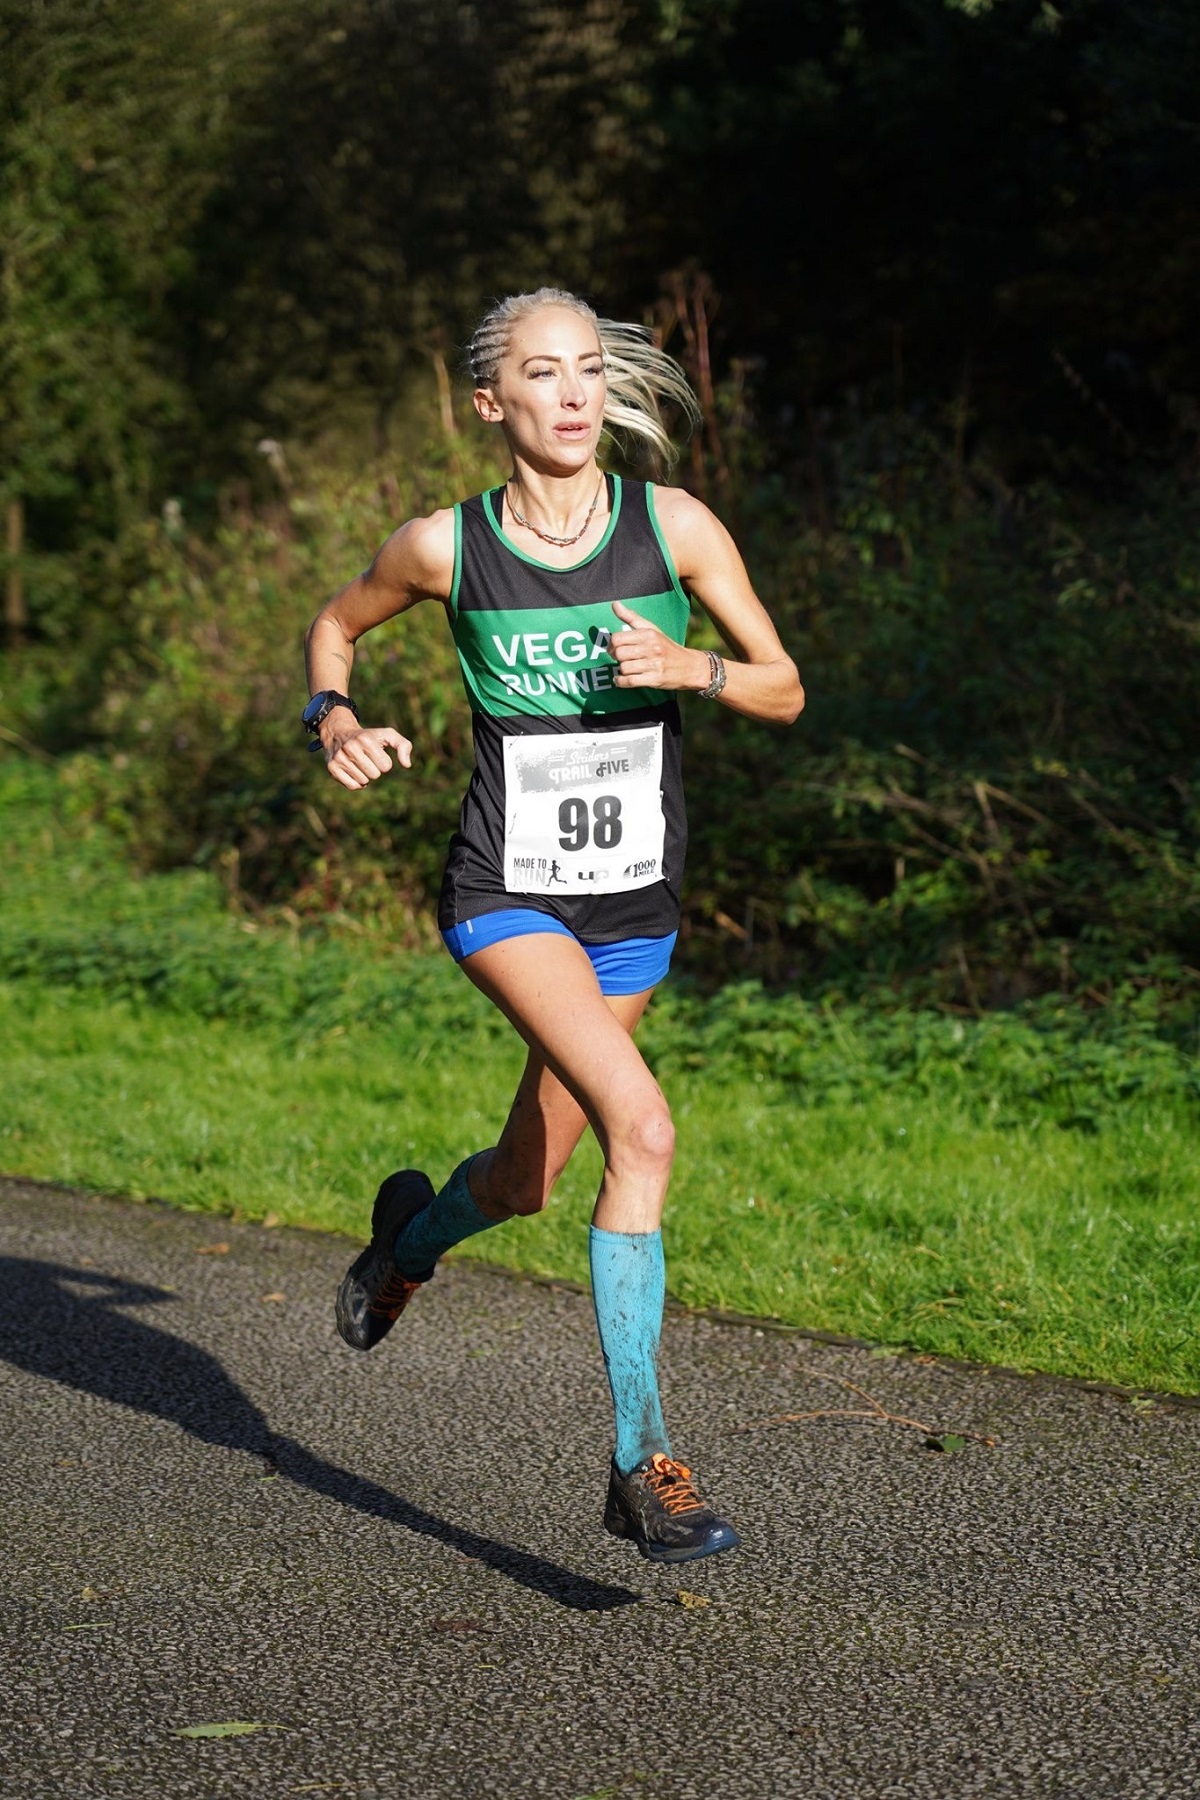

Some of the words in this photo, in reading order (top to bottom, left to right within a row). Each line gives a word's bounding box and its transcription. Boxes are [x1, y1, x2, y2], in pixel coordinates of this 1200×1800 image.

[492, 624, 632, 667] VEGA
[499, 666, 621, 696] RUNNE
[548, 764, 592, 784] TRAIL
[595, 758, 630, 778] FIVE
[558, 795, 623, 852] 98
[513, 857, 535, 869] MADE
[537, 857, 547, 869] TO
[632, 858, 656, 878] 1000
[638, 868, 655, 877] MILE
[513, 869, 546, 886] RUN
